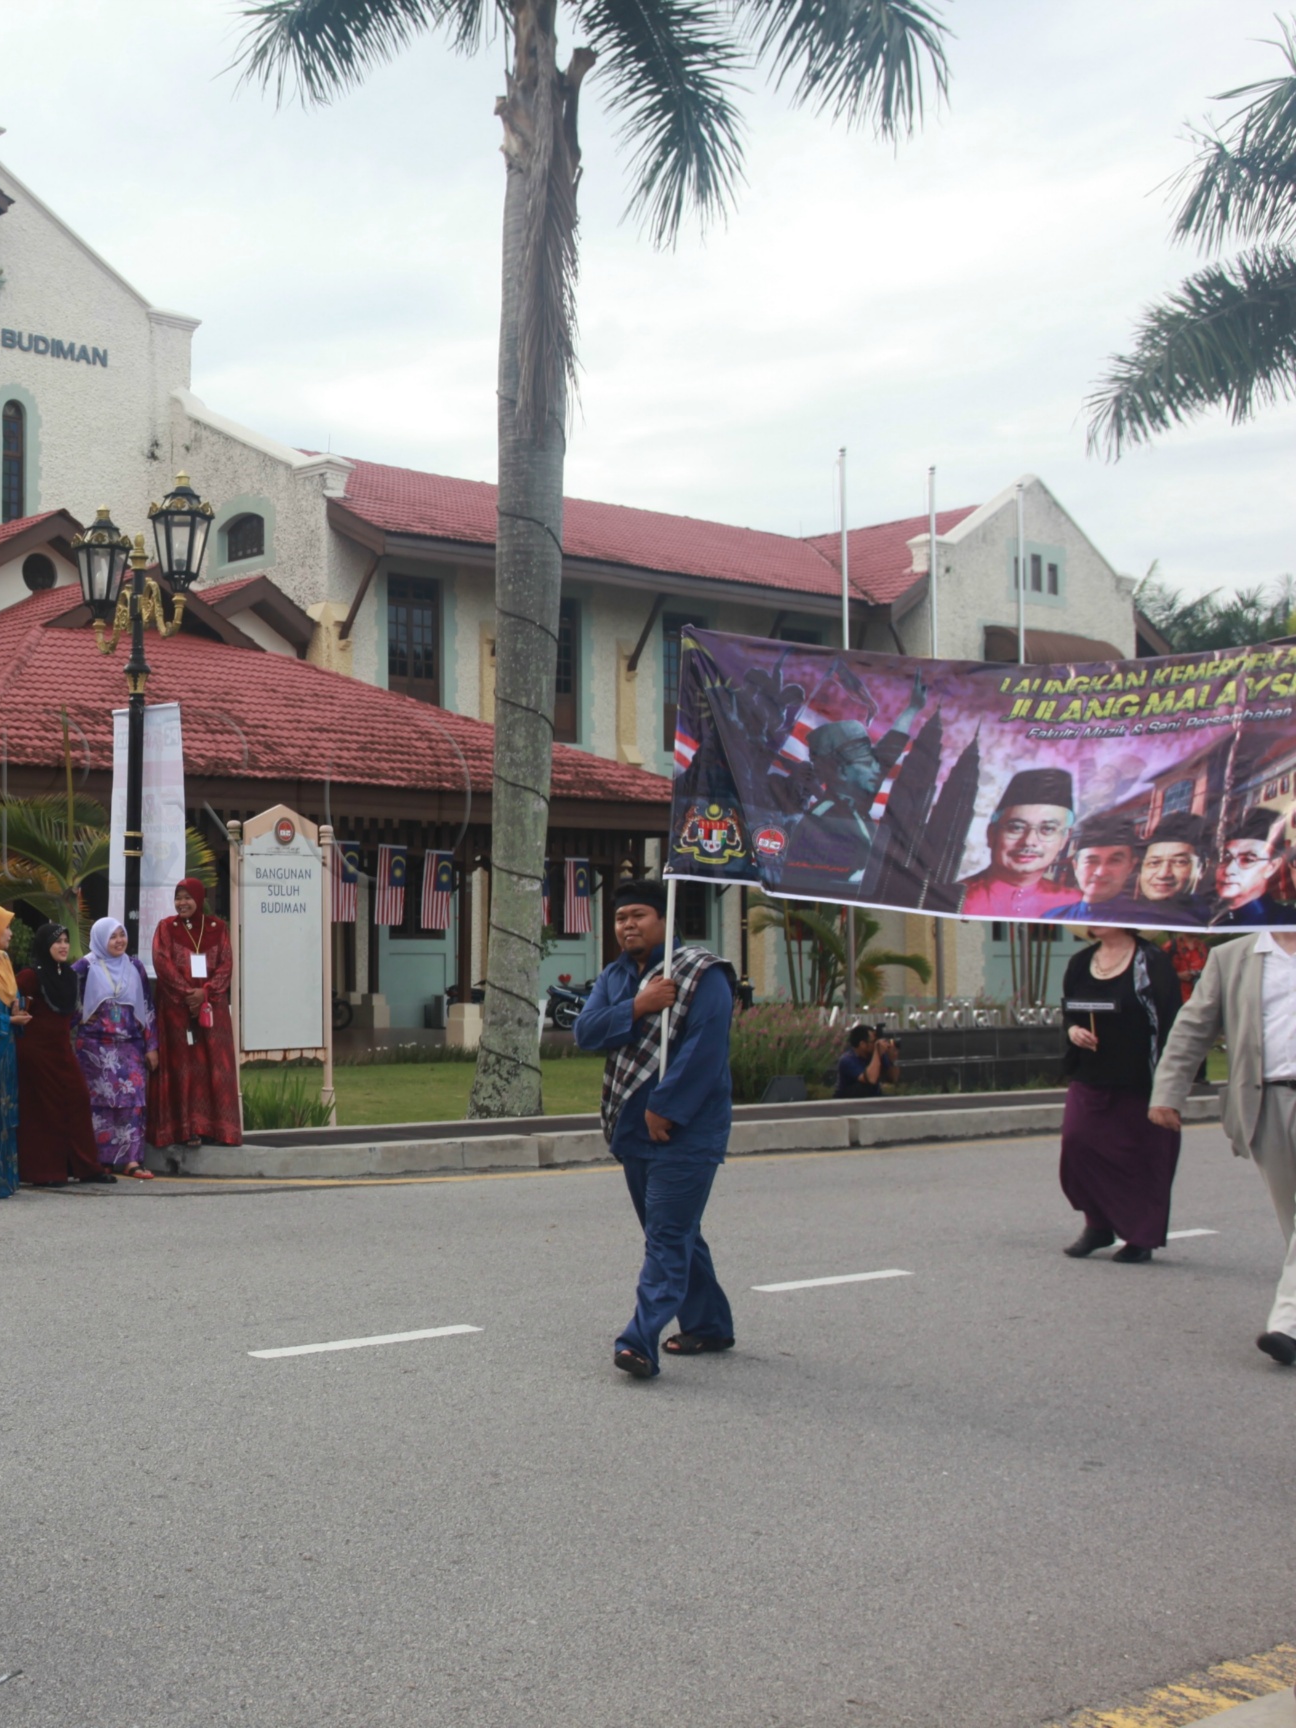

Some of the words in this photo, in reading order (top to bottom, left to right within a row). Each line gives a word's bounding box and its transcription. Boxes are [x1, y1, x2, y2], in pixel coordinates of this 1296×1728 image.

[1, 328, 108, 368] BUDIMAN
[1000, 694, 1141, 723] JULANG
[1082, 725, 1126, 740] Muzik
[1130, 724, 1142, 736] &
[1146, 720, 1181, 735] Seni
[1185, 707, 1293, 730] Persembahan
[255, 867, 312, 880] BANGUNAN
[267, 884, 300, 897] SULUH
[260, 902, 307, 914] BUDIMAN
